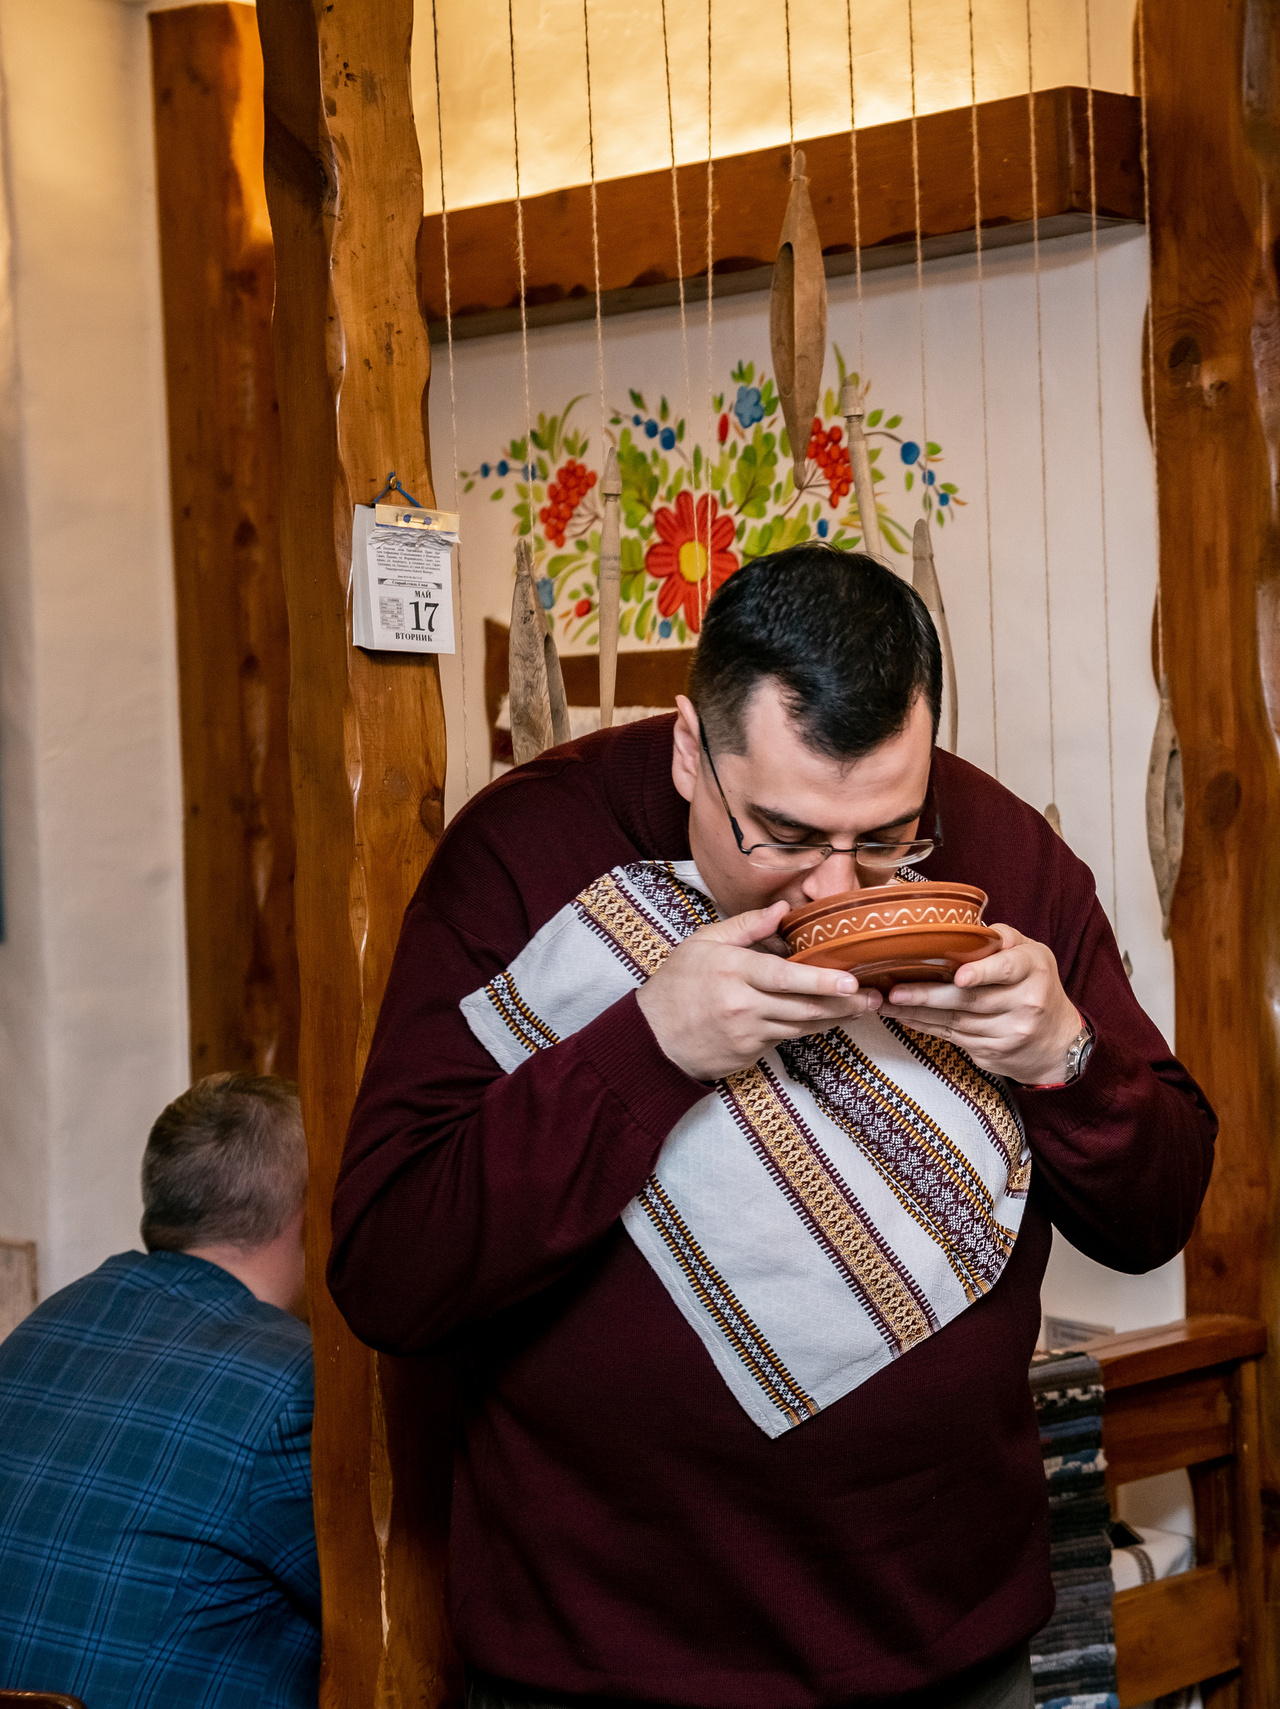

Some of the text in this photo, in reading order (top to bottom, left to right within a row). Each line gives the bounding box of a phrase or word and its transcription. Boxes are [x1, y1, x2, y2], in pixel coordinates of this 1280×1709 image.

[414, 590, 432, 599] МАЙ
[409, 601, 439, 632] 17
[395, 632, 433, 641] ВТОРНИК
